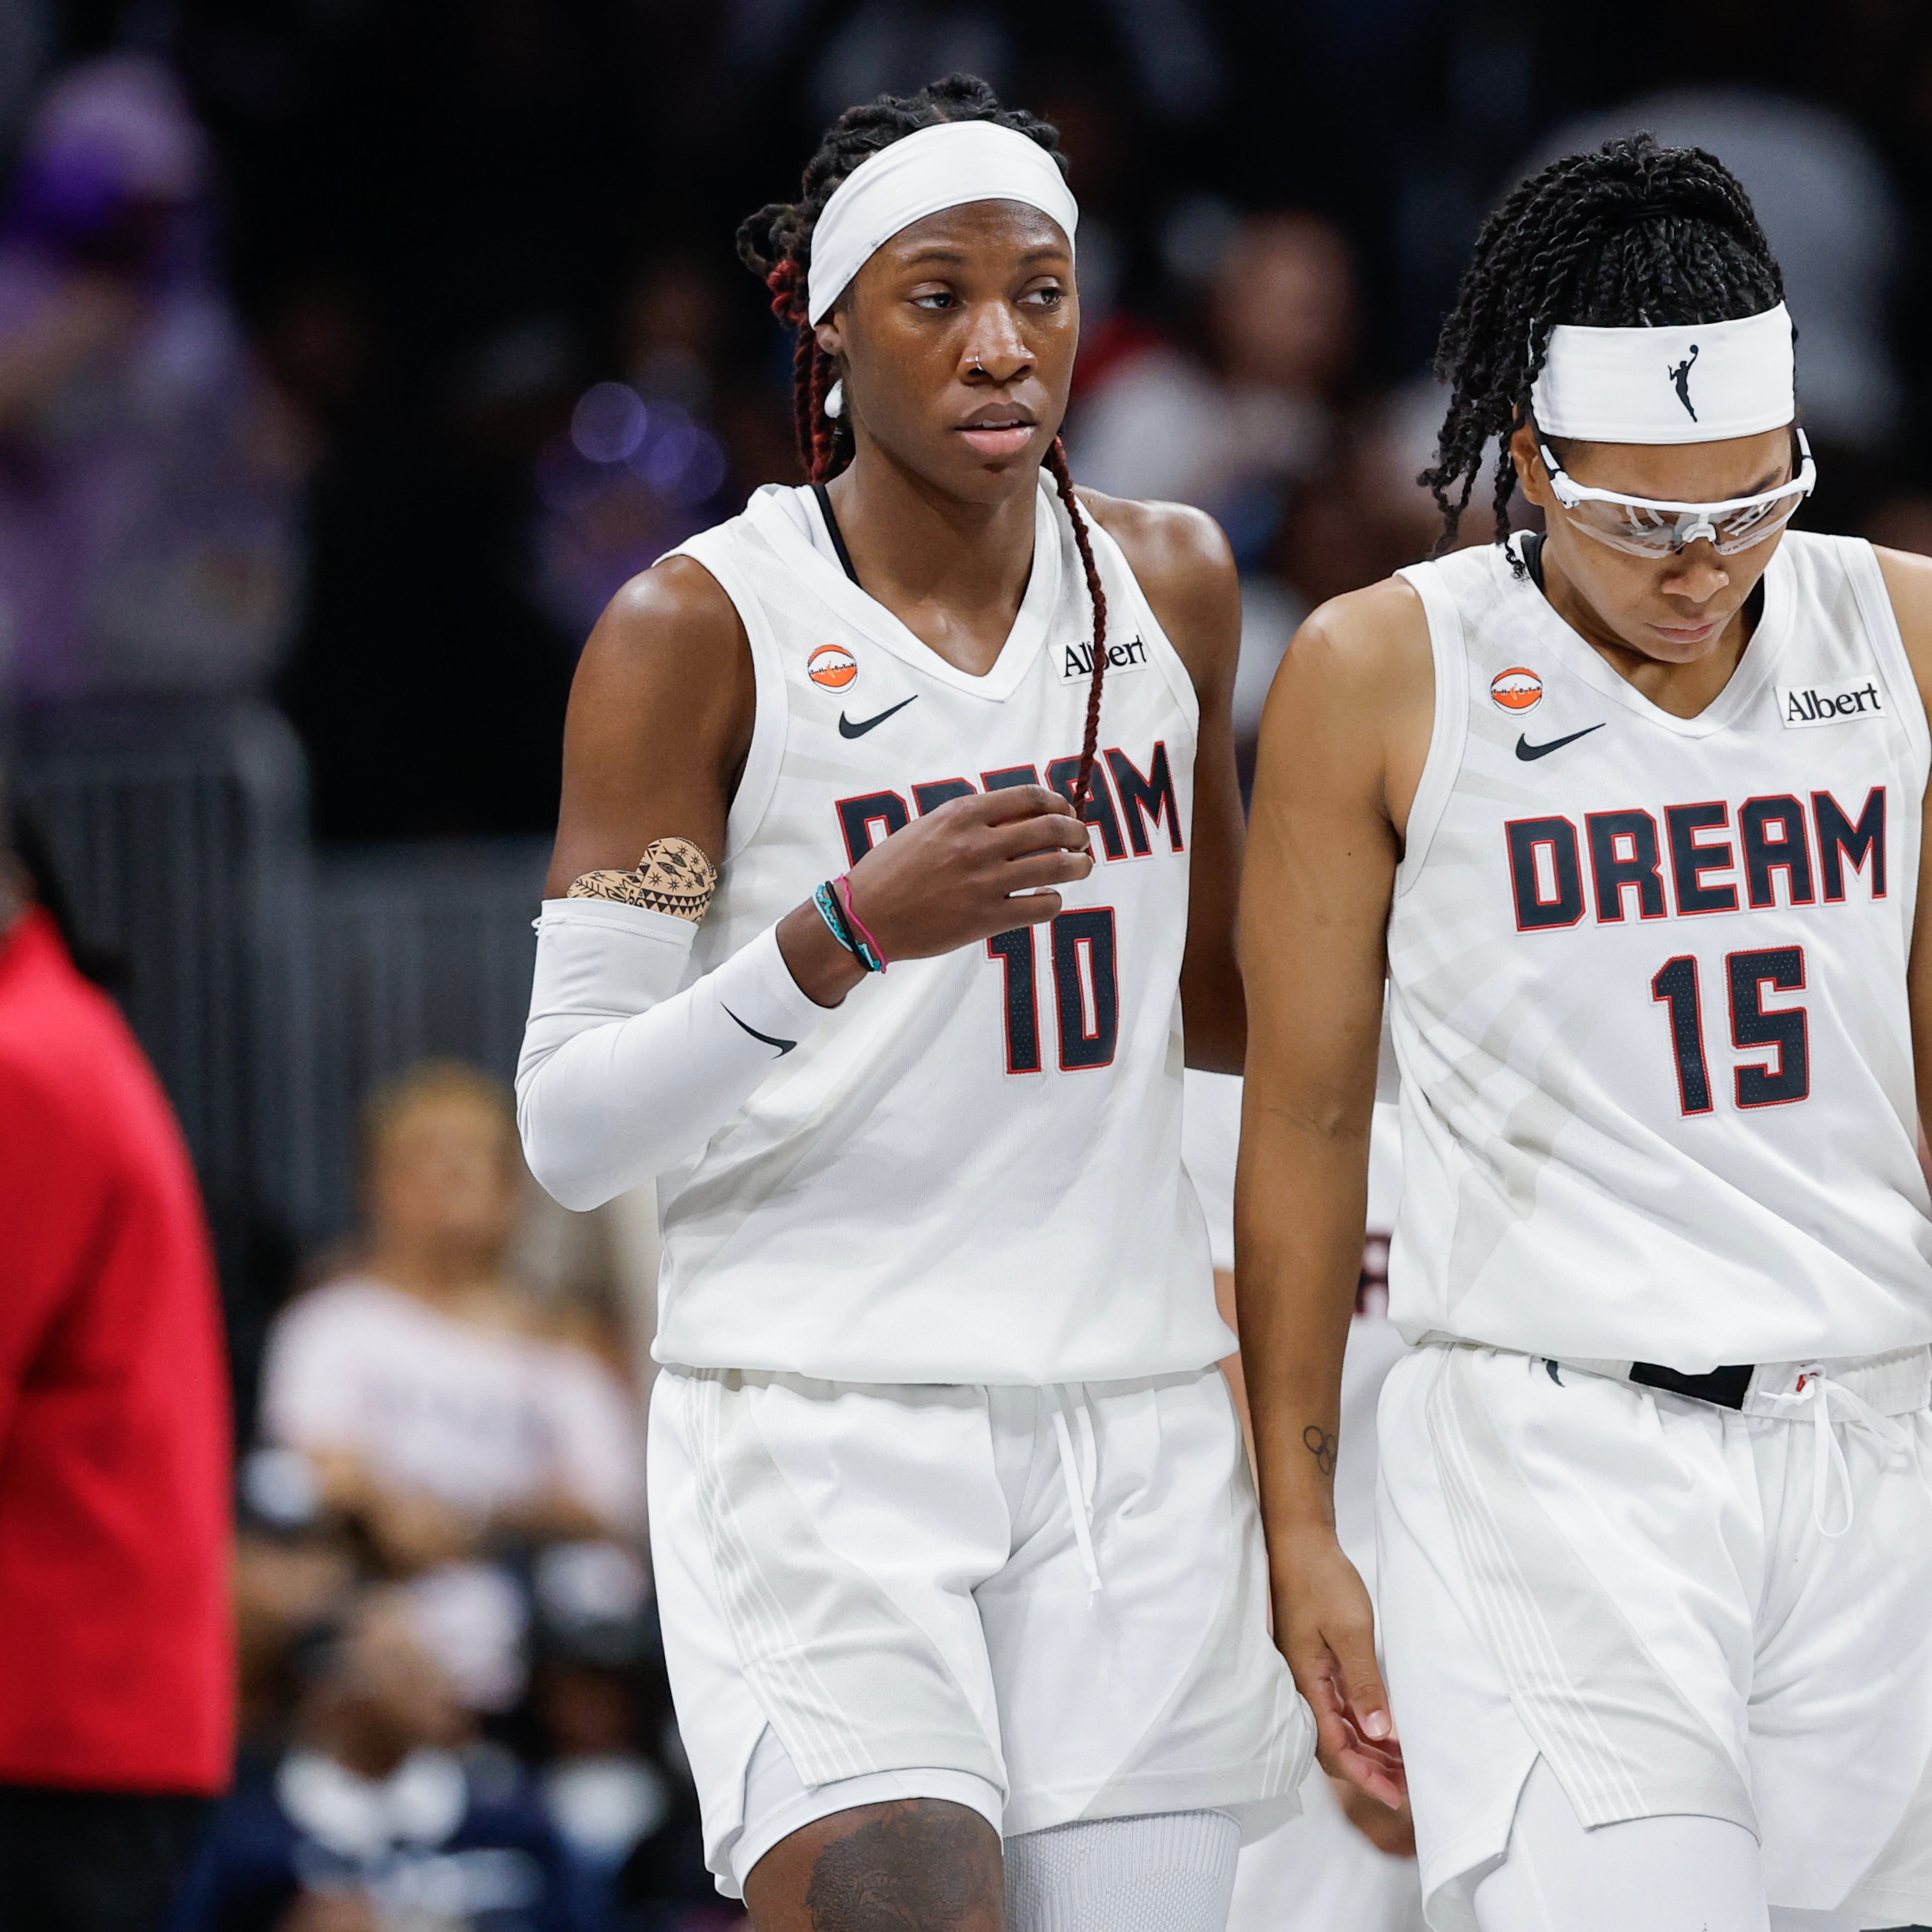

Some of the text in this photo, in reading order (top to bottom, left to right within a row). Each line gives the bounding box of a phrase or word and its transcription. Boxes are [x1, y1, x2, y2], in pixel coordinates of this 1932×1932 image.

[1787, 683, 1881, 721] Albert
[835, 741, 1184, 870] DAM
[1504, 786, 1887, 931] DREAM
[987, 907, 1119, 1075] 10
[1651, 945, 1810, 1116] 15
